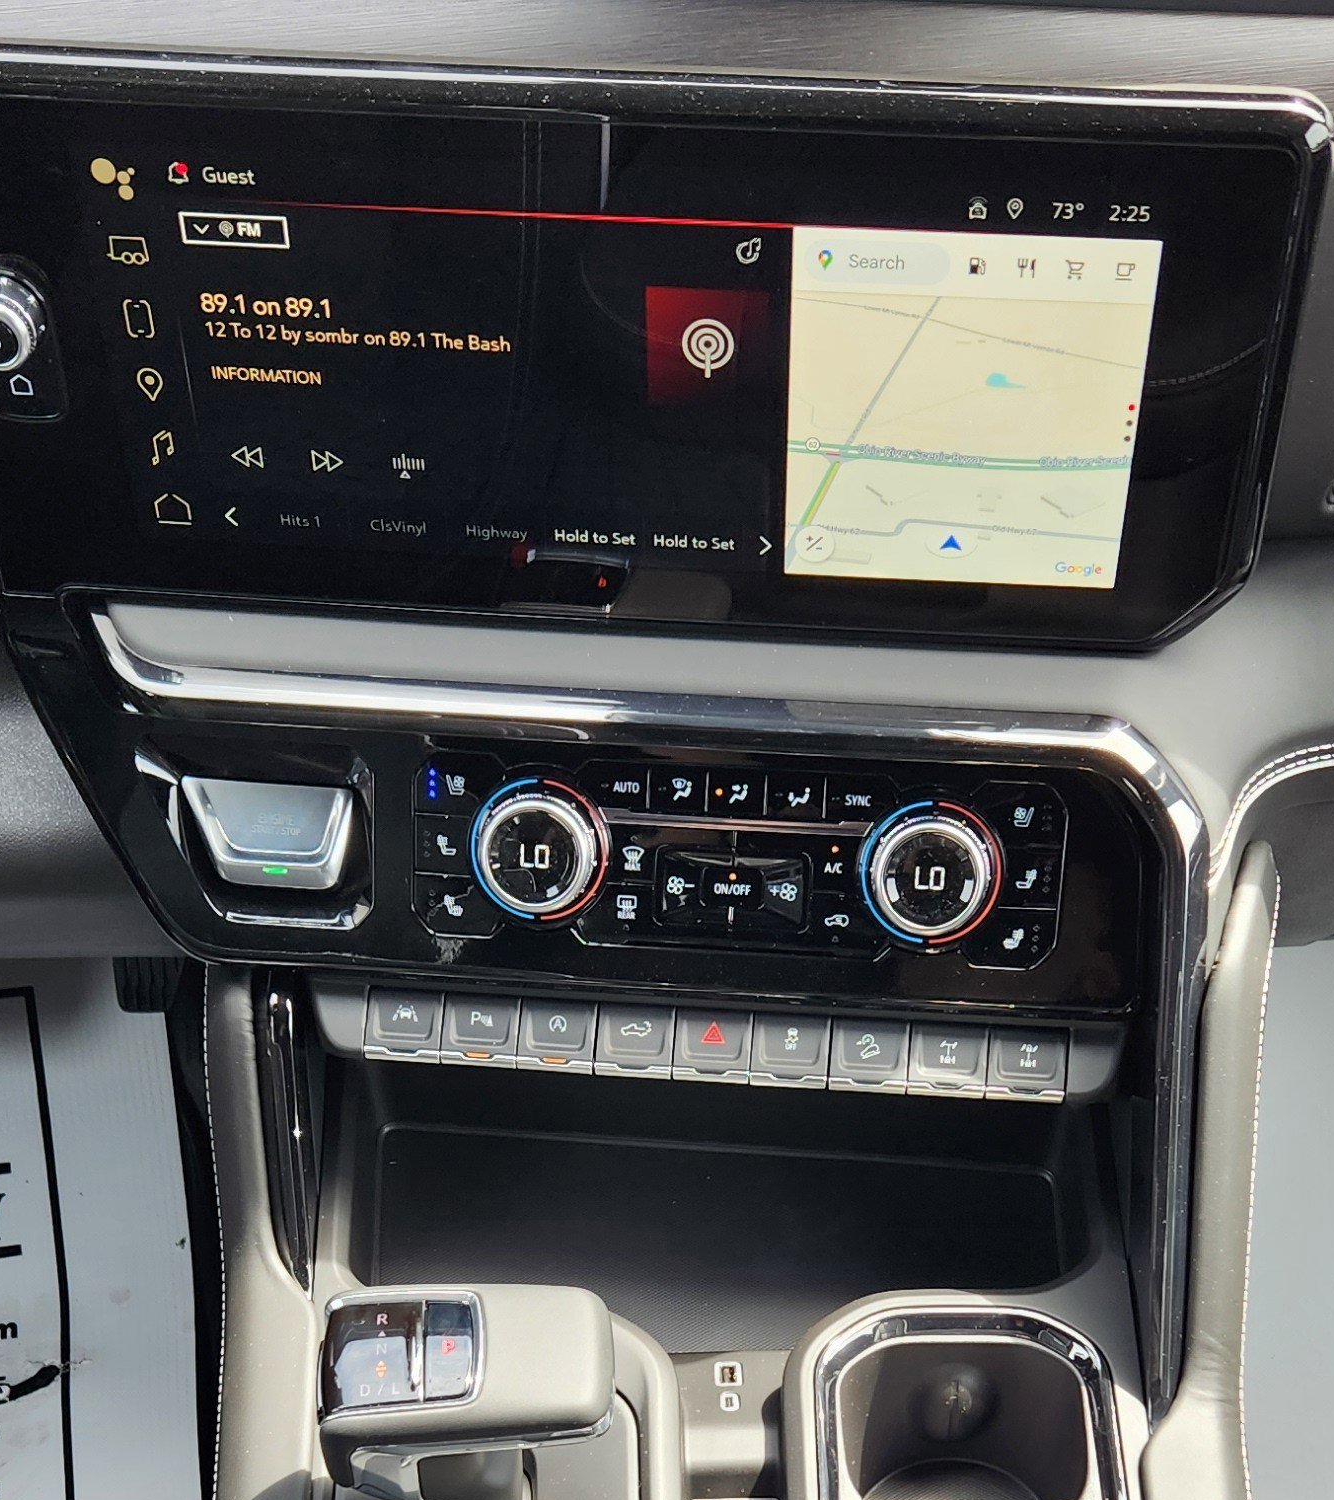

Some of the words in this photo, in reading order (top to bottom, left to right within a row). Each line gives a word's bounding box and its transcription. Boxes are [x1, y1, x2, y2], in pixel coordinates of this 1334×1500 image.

[202, 166, 256, 186] Guest
[1051, 201, 1085, 221] 73°
[1108, 204, 1152, 222] 2:25
[236, 221, 262, 238] FM
[848, 253, 906, 272] Search
[199, 291, 247, 315] 89.1
[251, 301, 282, 318] on
[284, 296, 332, 320] 89.1
[204, 321, 227, 338] 12
[228, 322, 251, 339] To
[254, 323, 277, 341] 12
[280, 324, 302, 346] by
[304, 327, 359, 346] sombr
[364, 333, 387, 347] on
[388, 331, 427, 349] 89.1
[429, 332, 465, 351] The
[468, 334, 512, 353] Bash
[210, 365, 323, 387] INFORMATION
[857, 443, 882, 456] Ohio
[884, 445, 911, 458] River
[953, 451, 987, 467] Byway
[280, 513, 311, 528] Hits
[313, 515, 321, 528] 1
[369, 518, 427, 536] ClsVinyl
[466, 524, 528, 542] Highway
[554, 529, 589, 545] Hold
[592, 532, 609, 546] to
[612, 532, 636, 547] Set
[653, 534, 688, 549] Hold
[691, 537, 708, 550] to
[711, 537, 736, 551] Set
[1055, 560, 1102, 577] Google
[612, 781, 640, 794] AUTO
[844, 794, 872, 808] SYNC
[823, 863, 843, 874] A/C
[713, 883, 751, 896] ON/OFF
[375, 1313, 388, 1326] R
[376, 1343, 388, 1356] N
[441, 1339, 456, 1354] P
